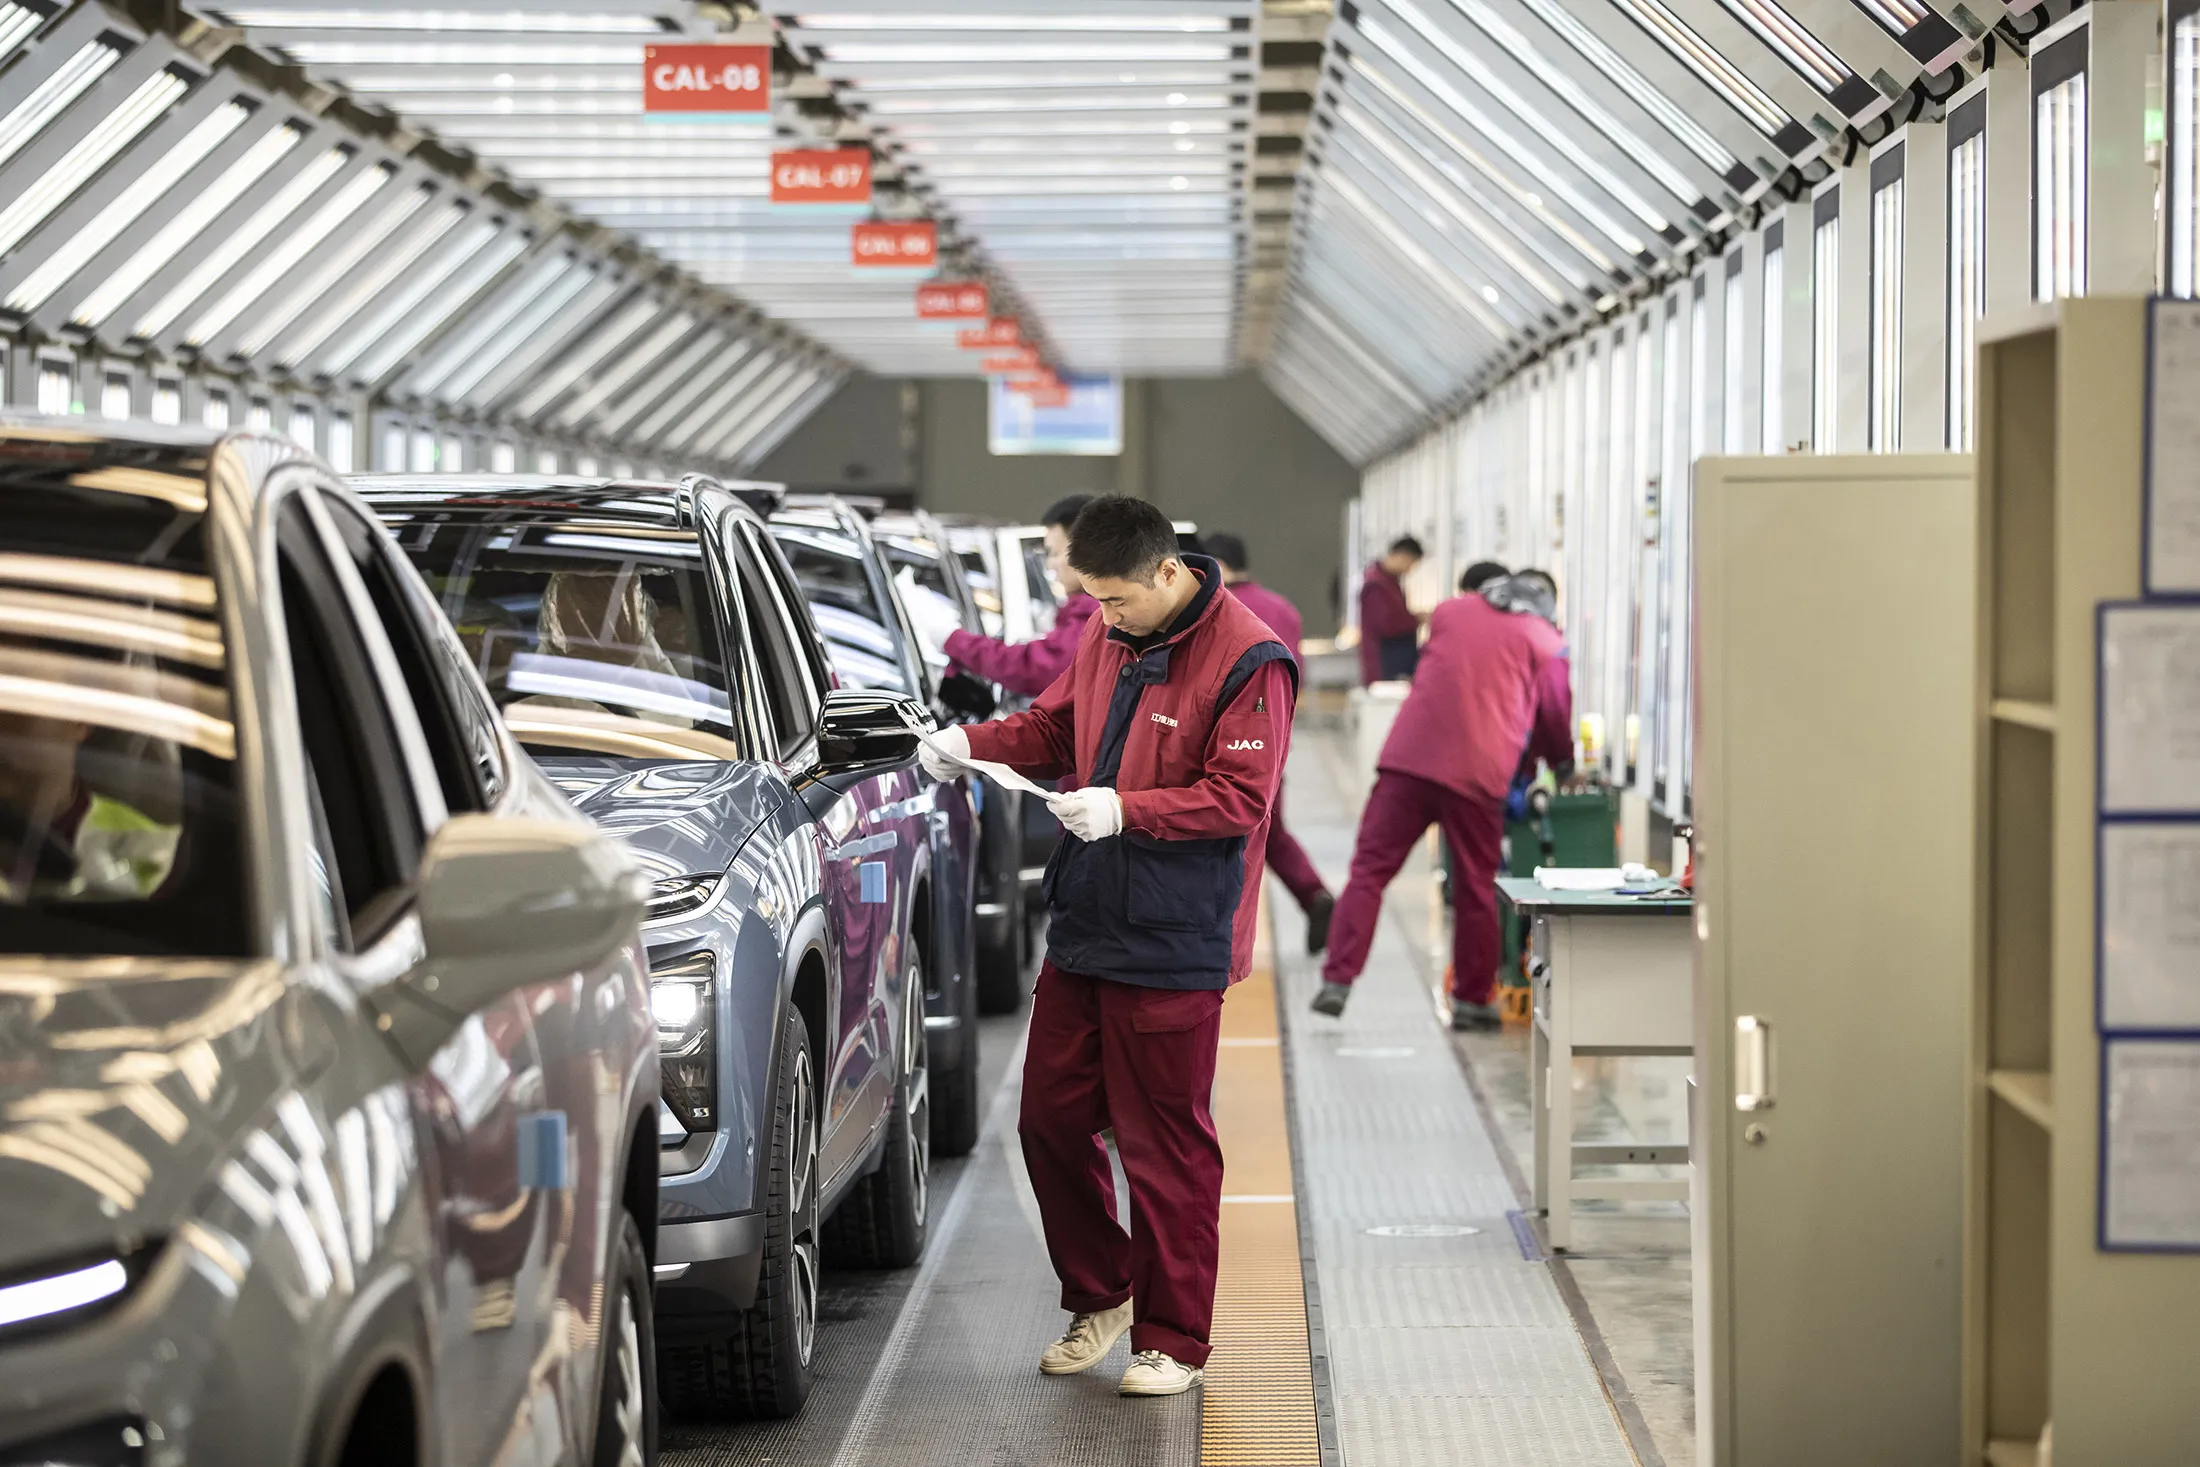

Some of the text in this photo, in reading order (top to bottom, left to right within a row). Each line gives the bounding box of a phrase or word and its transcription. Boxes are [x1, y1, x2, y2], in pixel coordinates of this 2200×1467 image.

[653, 65, 760, 91] CAL-08
[776, 165, 863, 189] CAL-07
[1227, 739, 1264, 751] JAC
